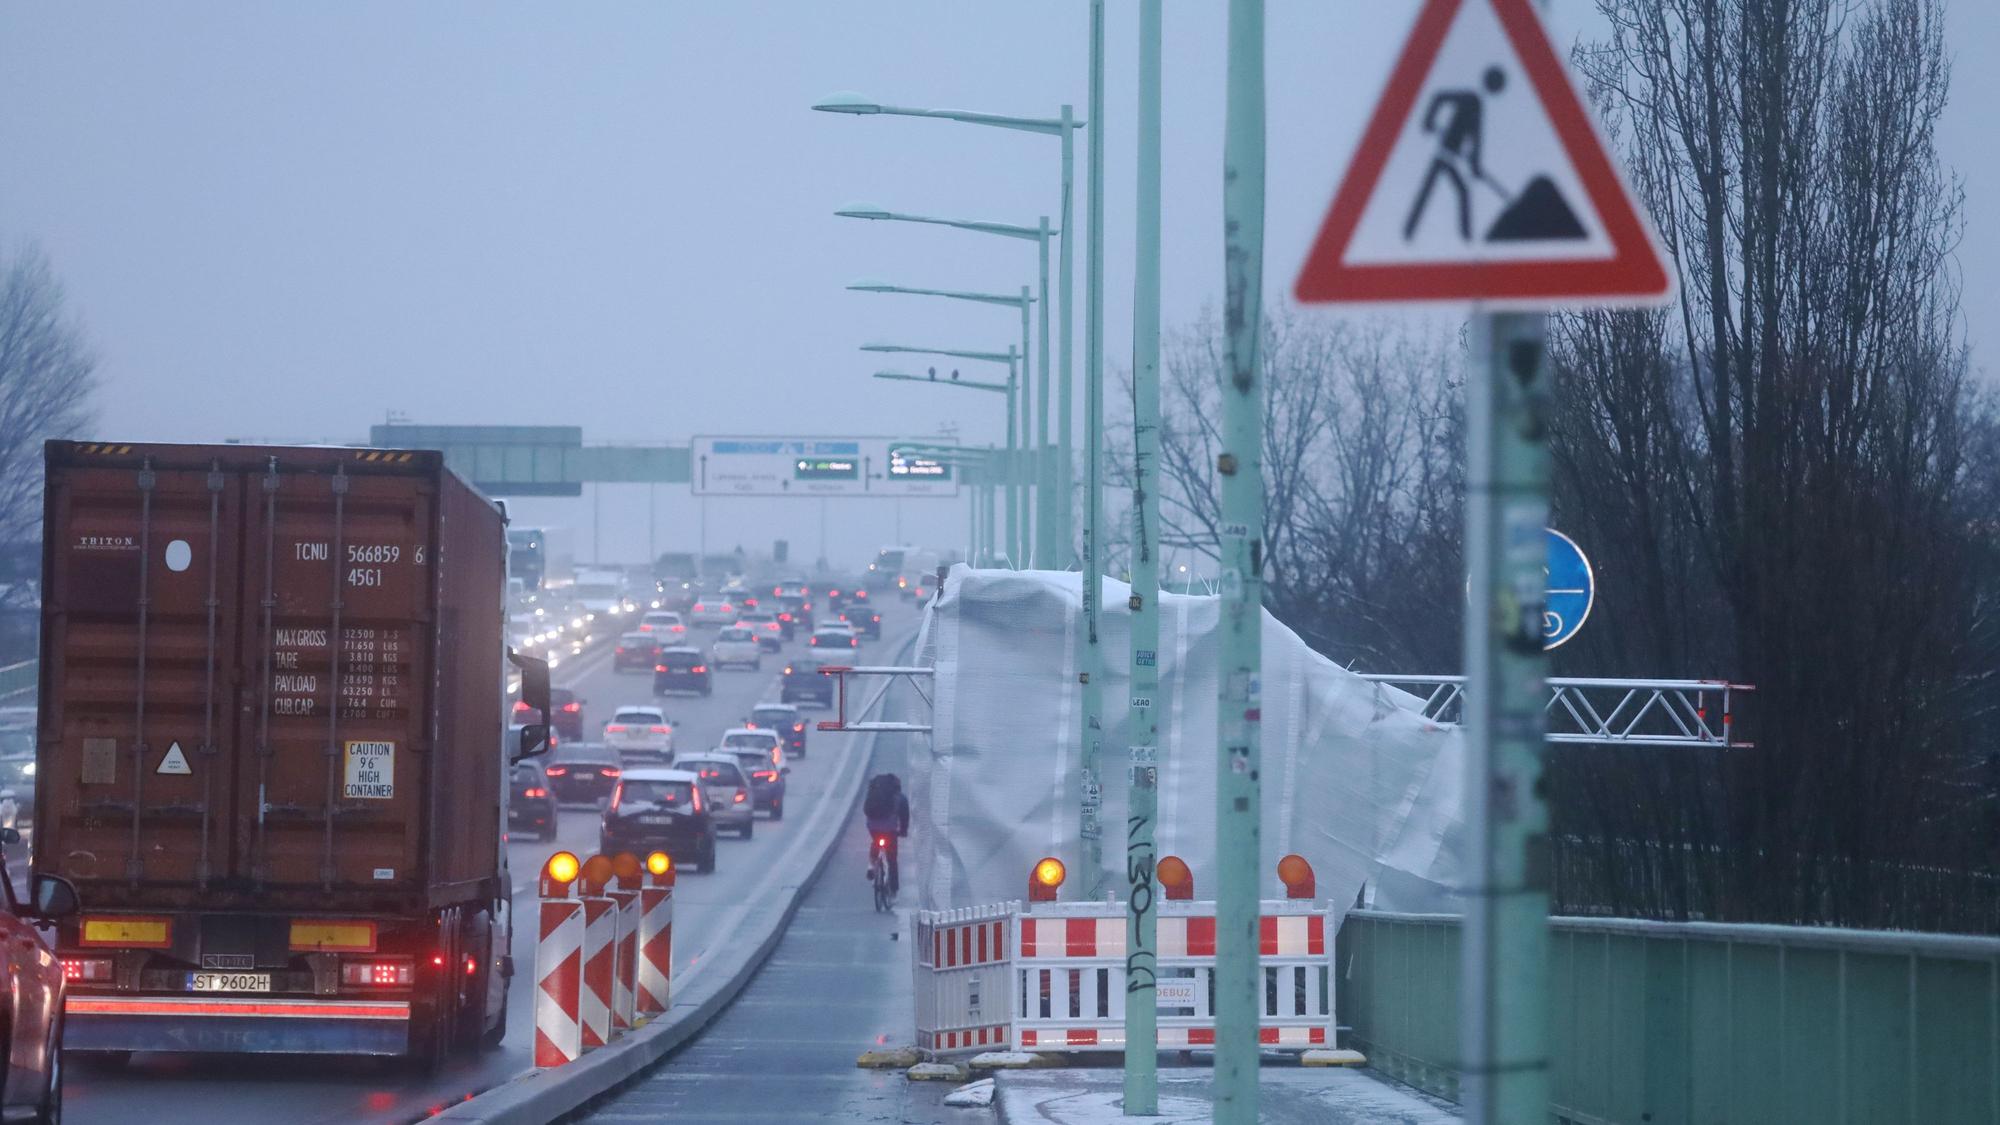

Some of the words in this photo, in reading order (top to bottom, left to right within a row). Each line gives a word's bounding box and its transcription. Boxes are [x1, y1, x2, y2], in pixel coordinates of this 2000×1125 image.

[80, 536, 133, 545] TRITON
[294, 543, 328, 561] TCNU
[347, 545, 400, 563] 566859
[415, 546, 424, 564] 6
[347, 568, 381, 586] 45G1
[344, 641, 374, 651] 71.650
[275, 652, 298, 669] TARE
[349, 652, 374, 662] 3.810
[382, 653, 398, 663] KGS
[274, 676, 317, 692] PAYLOAD
[382, 676, 398, 685] KGS
[342, 687, 373, 696] 63.250
[350, 743, 390, 756] CAUTION
[358, 770, 380, 783] HIGH
[344, 784, 393, 797] CONTAINER
[195, 975, 216, 989] ST
[220, 975, 267, 990] 9602H
